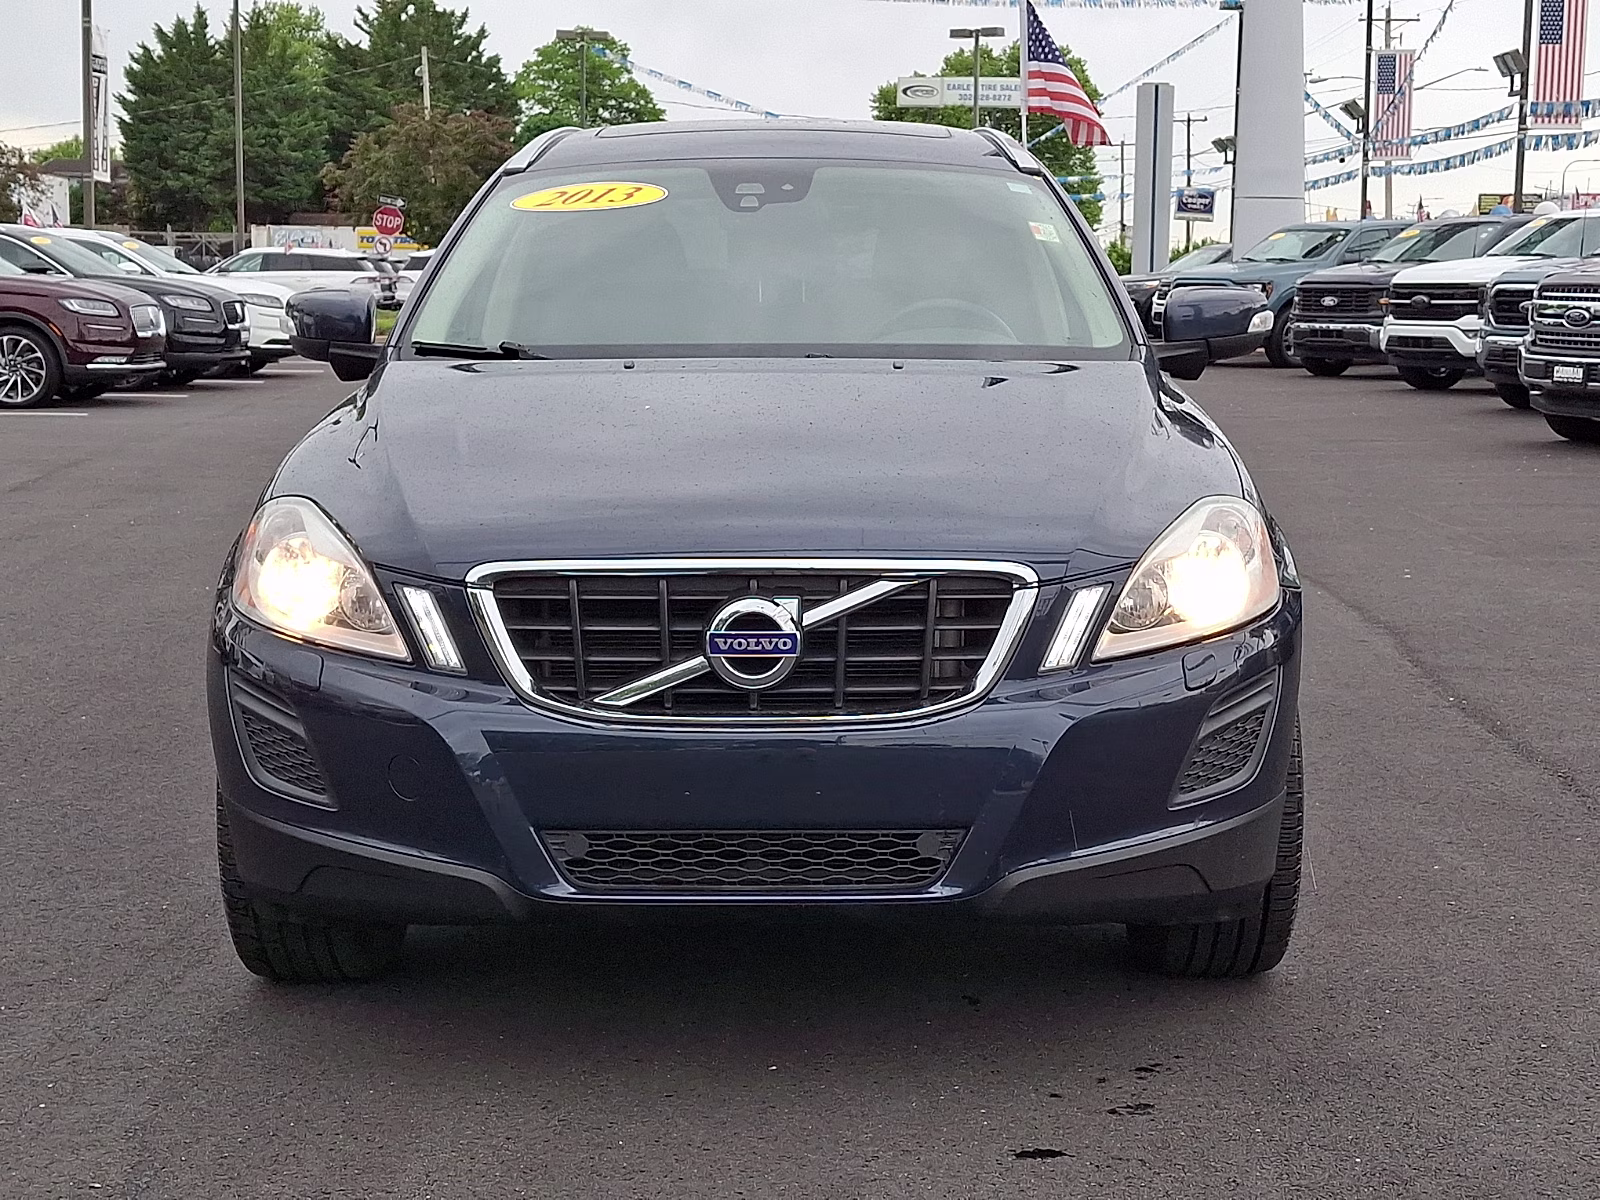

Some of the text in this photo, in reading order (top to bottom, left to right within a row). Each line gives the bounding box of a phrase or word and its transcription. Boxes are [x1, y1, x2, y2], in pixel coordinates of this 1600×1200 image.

[946, 83, 975, 91] EARLE
[981, 84, 997, 92] TIRE
[533, 186, 643, 207] 2013
[375, 213, 402, 229] STOP
[714, 638, 793, 650] VOLVO
